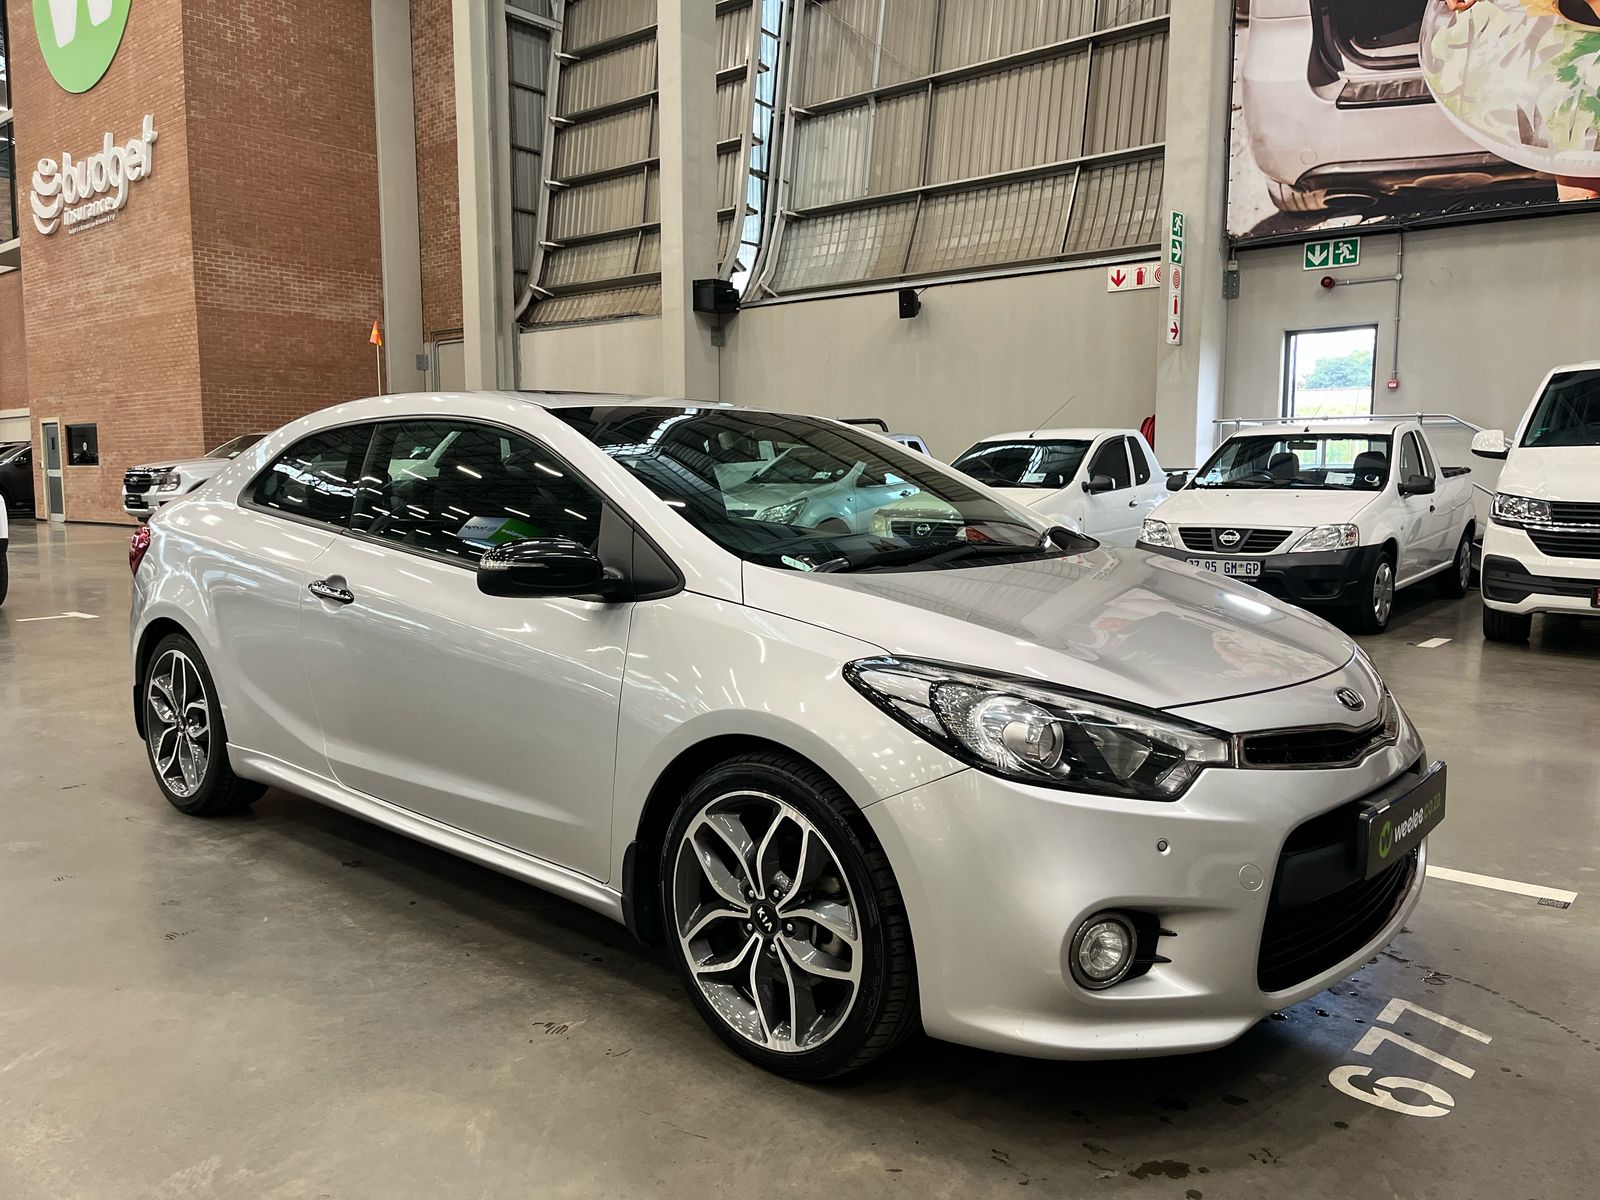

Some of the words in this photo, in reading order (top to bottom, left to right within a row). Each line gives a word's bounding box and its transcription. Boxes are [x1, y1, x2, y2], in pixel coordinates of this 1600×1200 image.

[62, 114, 158, 209] budget
[63, 197, 115, 225] insurance
[1245, 563, 1259, 575] GP
[757, 907, 773, 932] KIA
[1328, 998, 1493, 1118] 677
